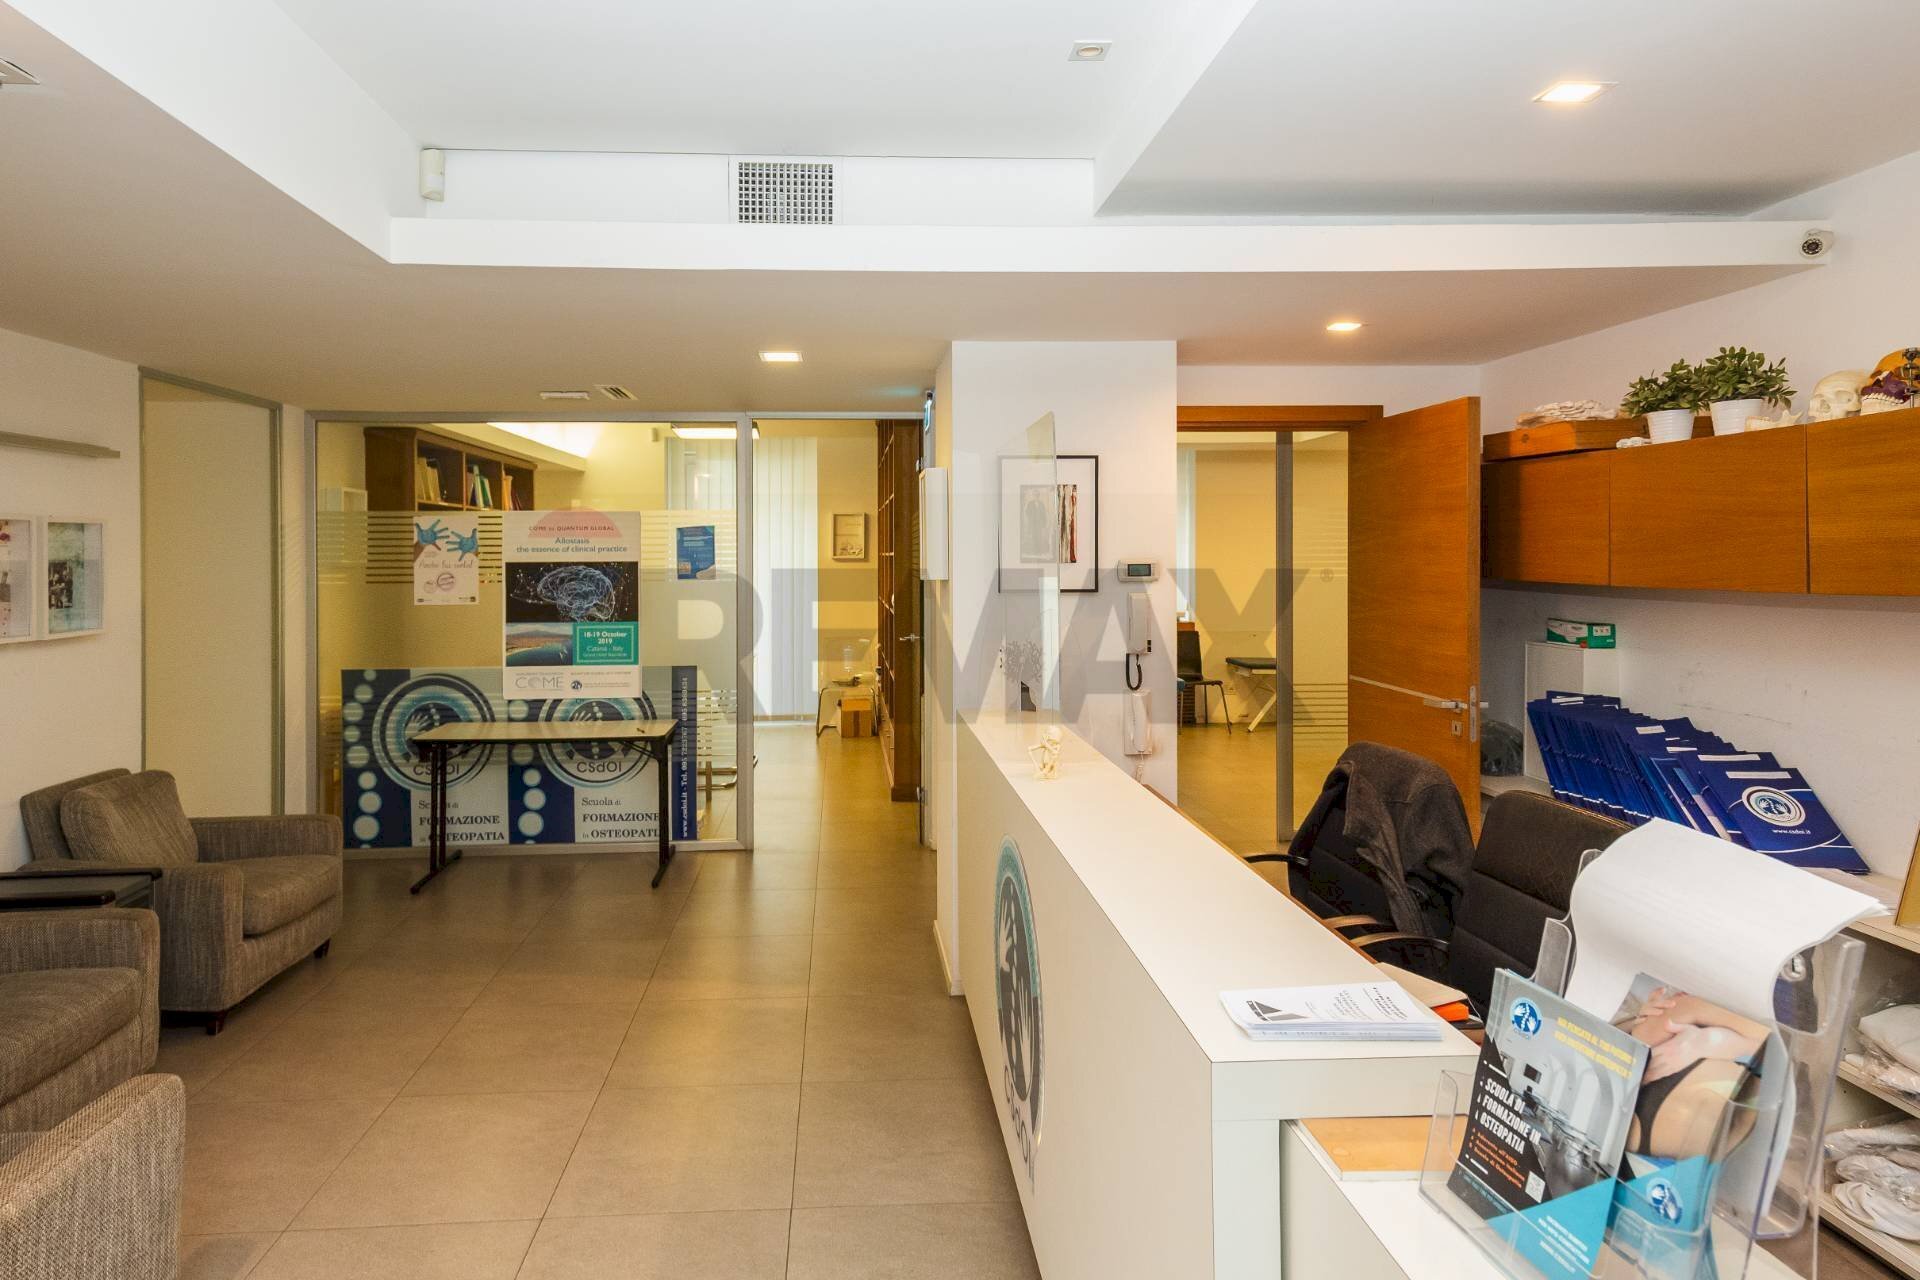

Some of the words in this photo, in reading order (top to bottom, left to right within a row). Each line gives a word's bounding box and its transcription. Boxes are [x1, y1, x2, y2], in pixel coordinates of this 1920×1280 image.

[571, 545, 596, 553] clinical
[597, 546, 627, 554] practice
[413, 763, 460, 776] CSOI
[680, 772, 688, 786] Tel.
[581, 797, 613, 806] Scuola
[591, 829, 660, 839] OSTEOPATI
[1485, 1078, 1514, 1107] SCUOLA
[1513, 1099, 1525, 1113] DI
[1482, 1095, 1531, 1138] FORMAZIONE
[1529, 1129, 1541, 1146] IN
[1480, 1112, 1525, 1154] OSTEOPATIA
